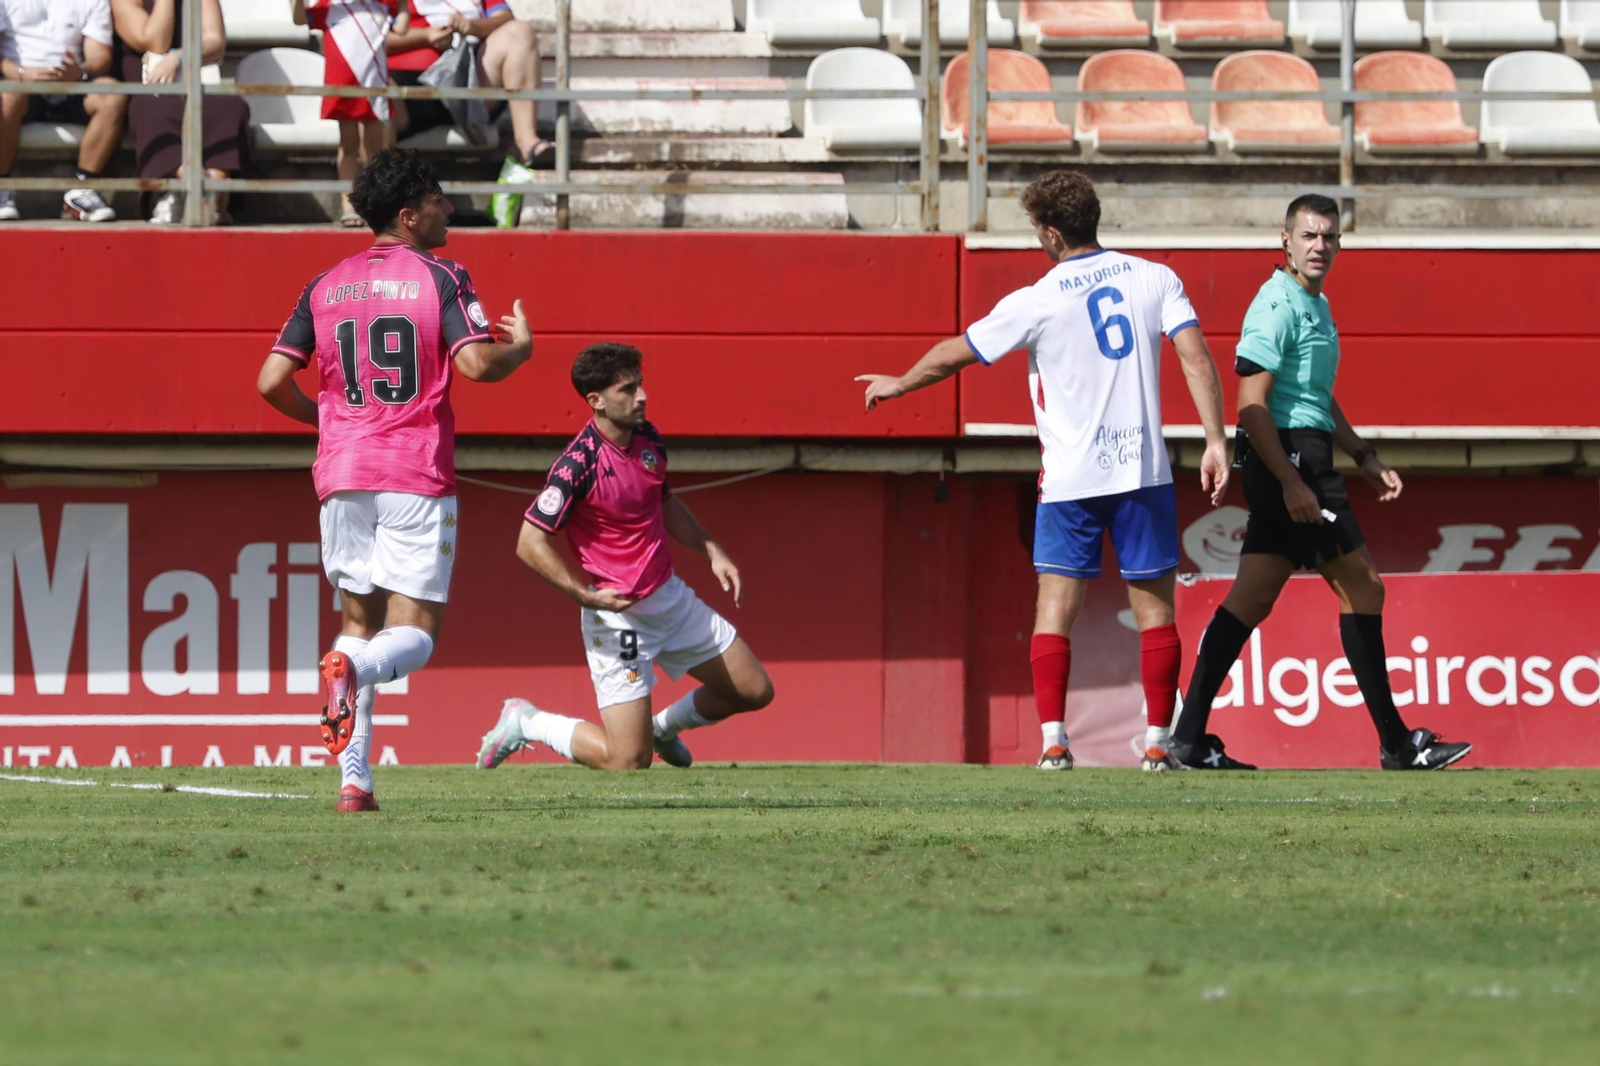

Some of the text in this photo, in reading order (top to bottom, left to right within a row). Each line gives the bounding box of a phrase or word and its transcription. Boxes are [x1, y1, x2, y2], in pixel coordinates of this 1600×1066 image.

[371, 280, 420, 299] PINTO
[1059, 261, 1132, 291] MAYORGA
[1086, 286, 1135, 361] 6
[335, 314, 419, 407] 19
[0, 503, 409, 696] Mafi
[619, 629, 638, 661] 9
[253, 745, 400, 767] MEA
